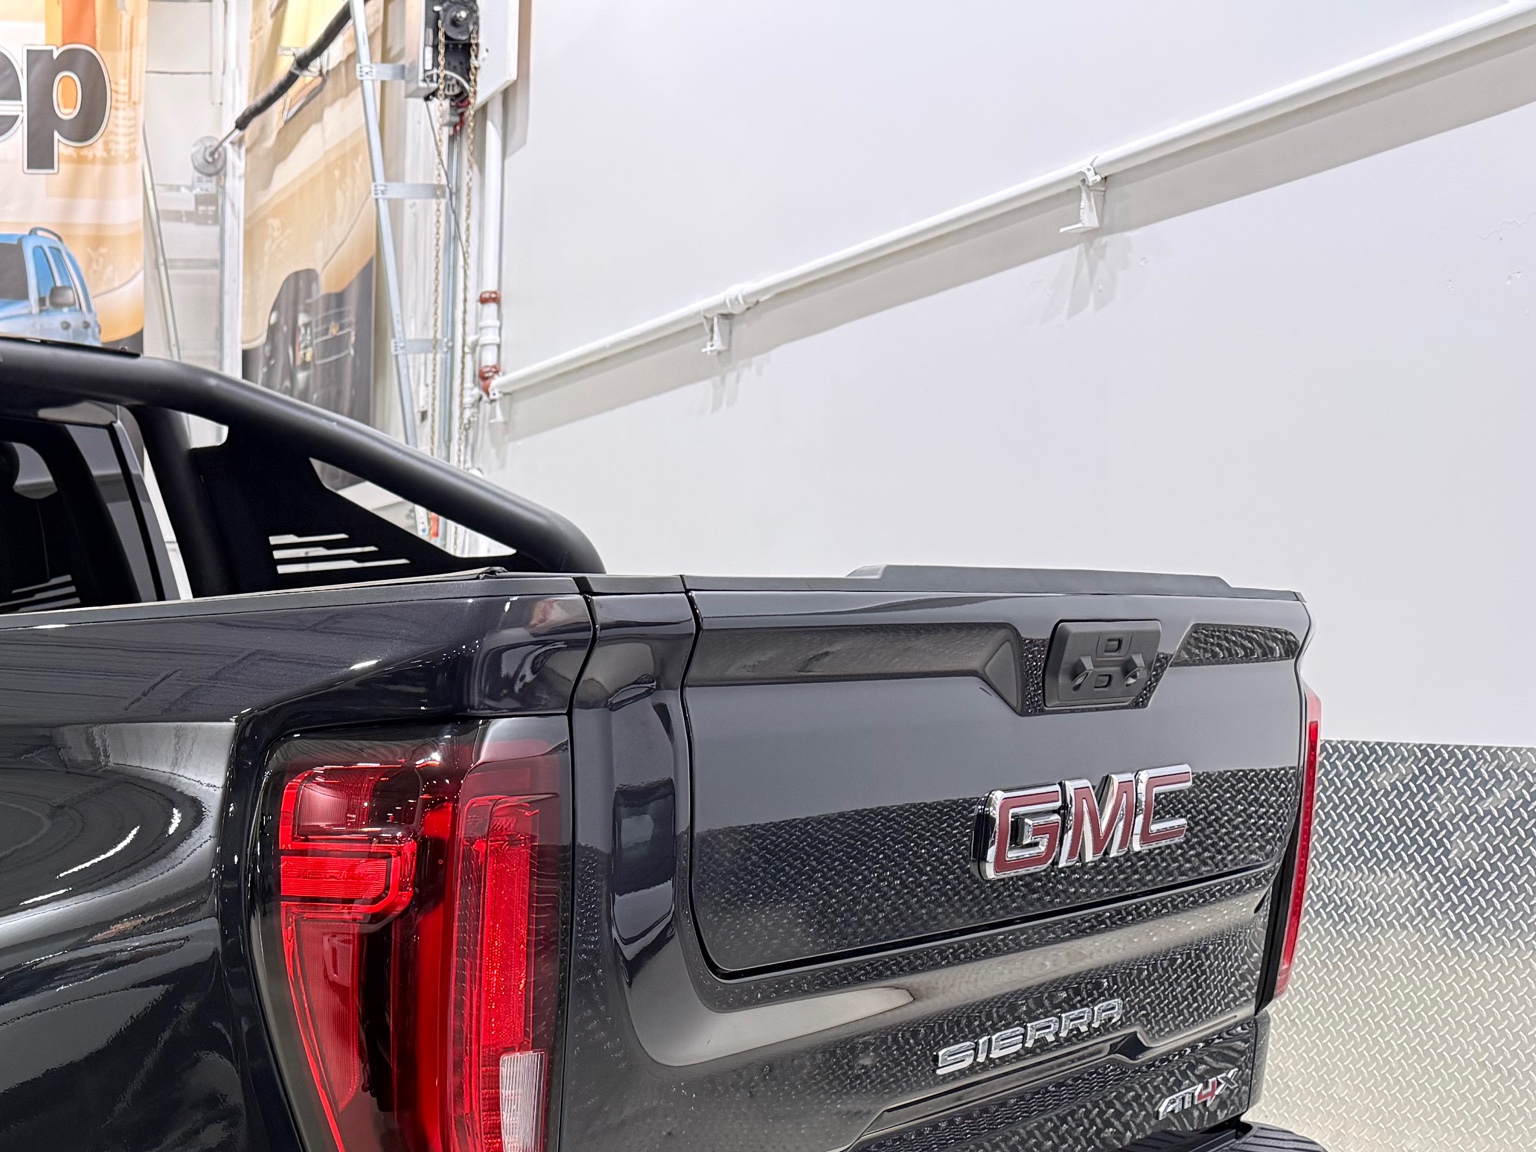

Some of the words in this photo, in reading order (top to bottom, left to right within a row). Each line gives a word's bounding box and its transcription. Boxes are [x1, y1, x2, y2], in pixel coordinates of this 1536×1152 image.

[970, 763, 1193, 881] GMC
[934, 998, 1124, 1075] SIERRA
[1154, 1067, 1239, 1121] AT4X
